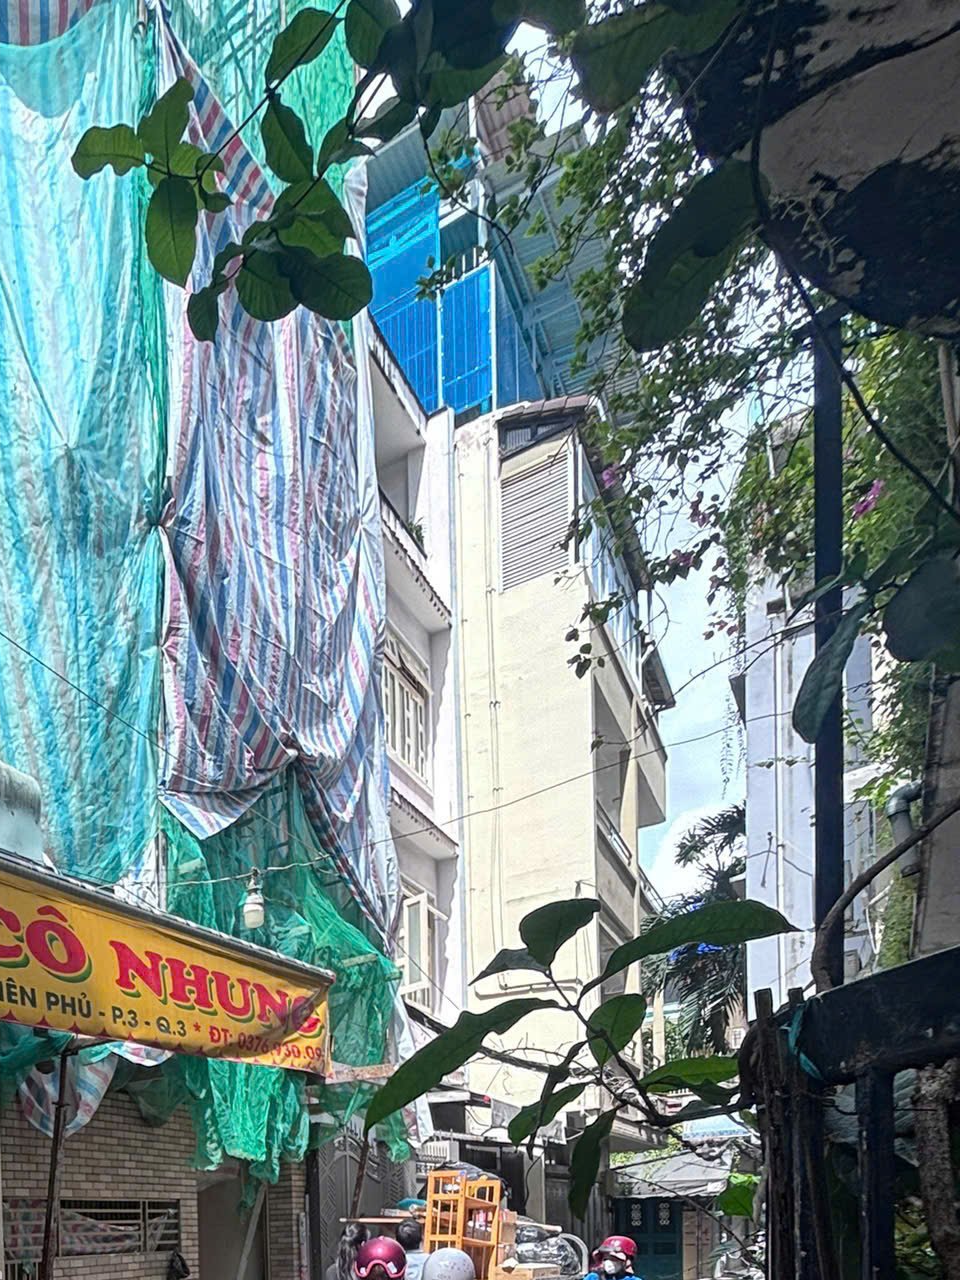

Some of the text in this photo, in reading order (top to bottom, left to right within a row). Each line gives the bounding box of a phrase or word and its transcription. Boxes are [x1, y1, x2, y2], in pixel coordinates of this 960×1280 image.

[46, 990, 92, 1019] PHỦ
[111, 1005, 139, 1029] P.3
[155, 1016, 188, 1038] Q.3
